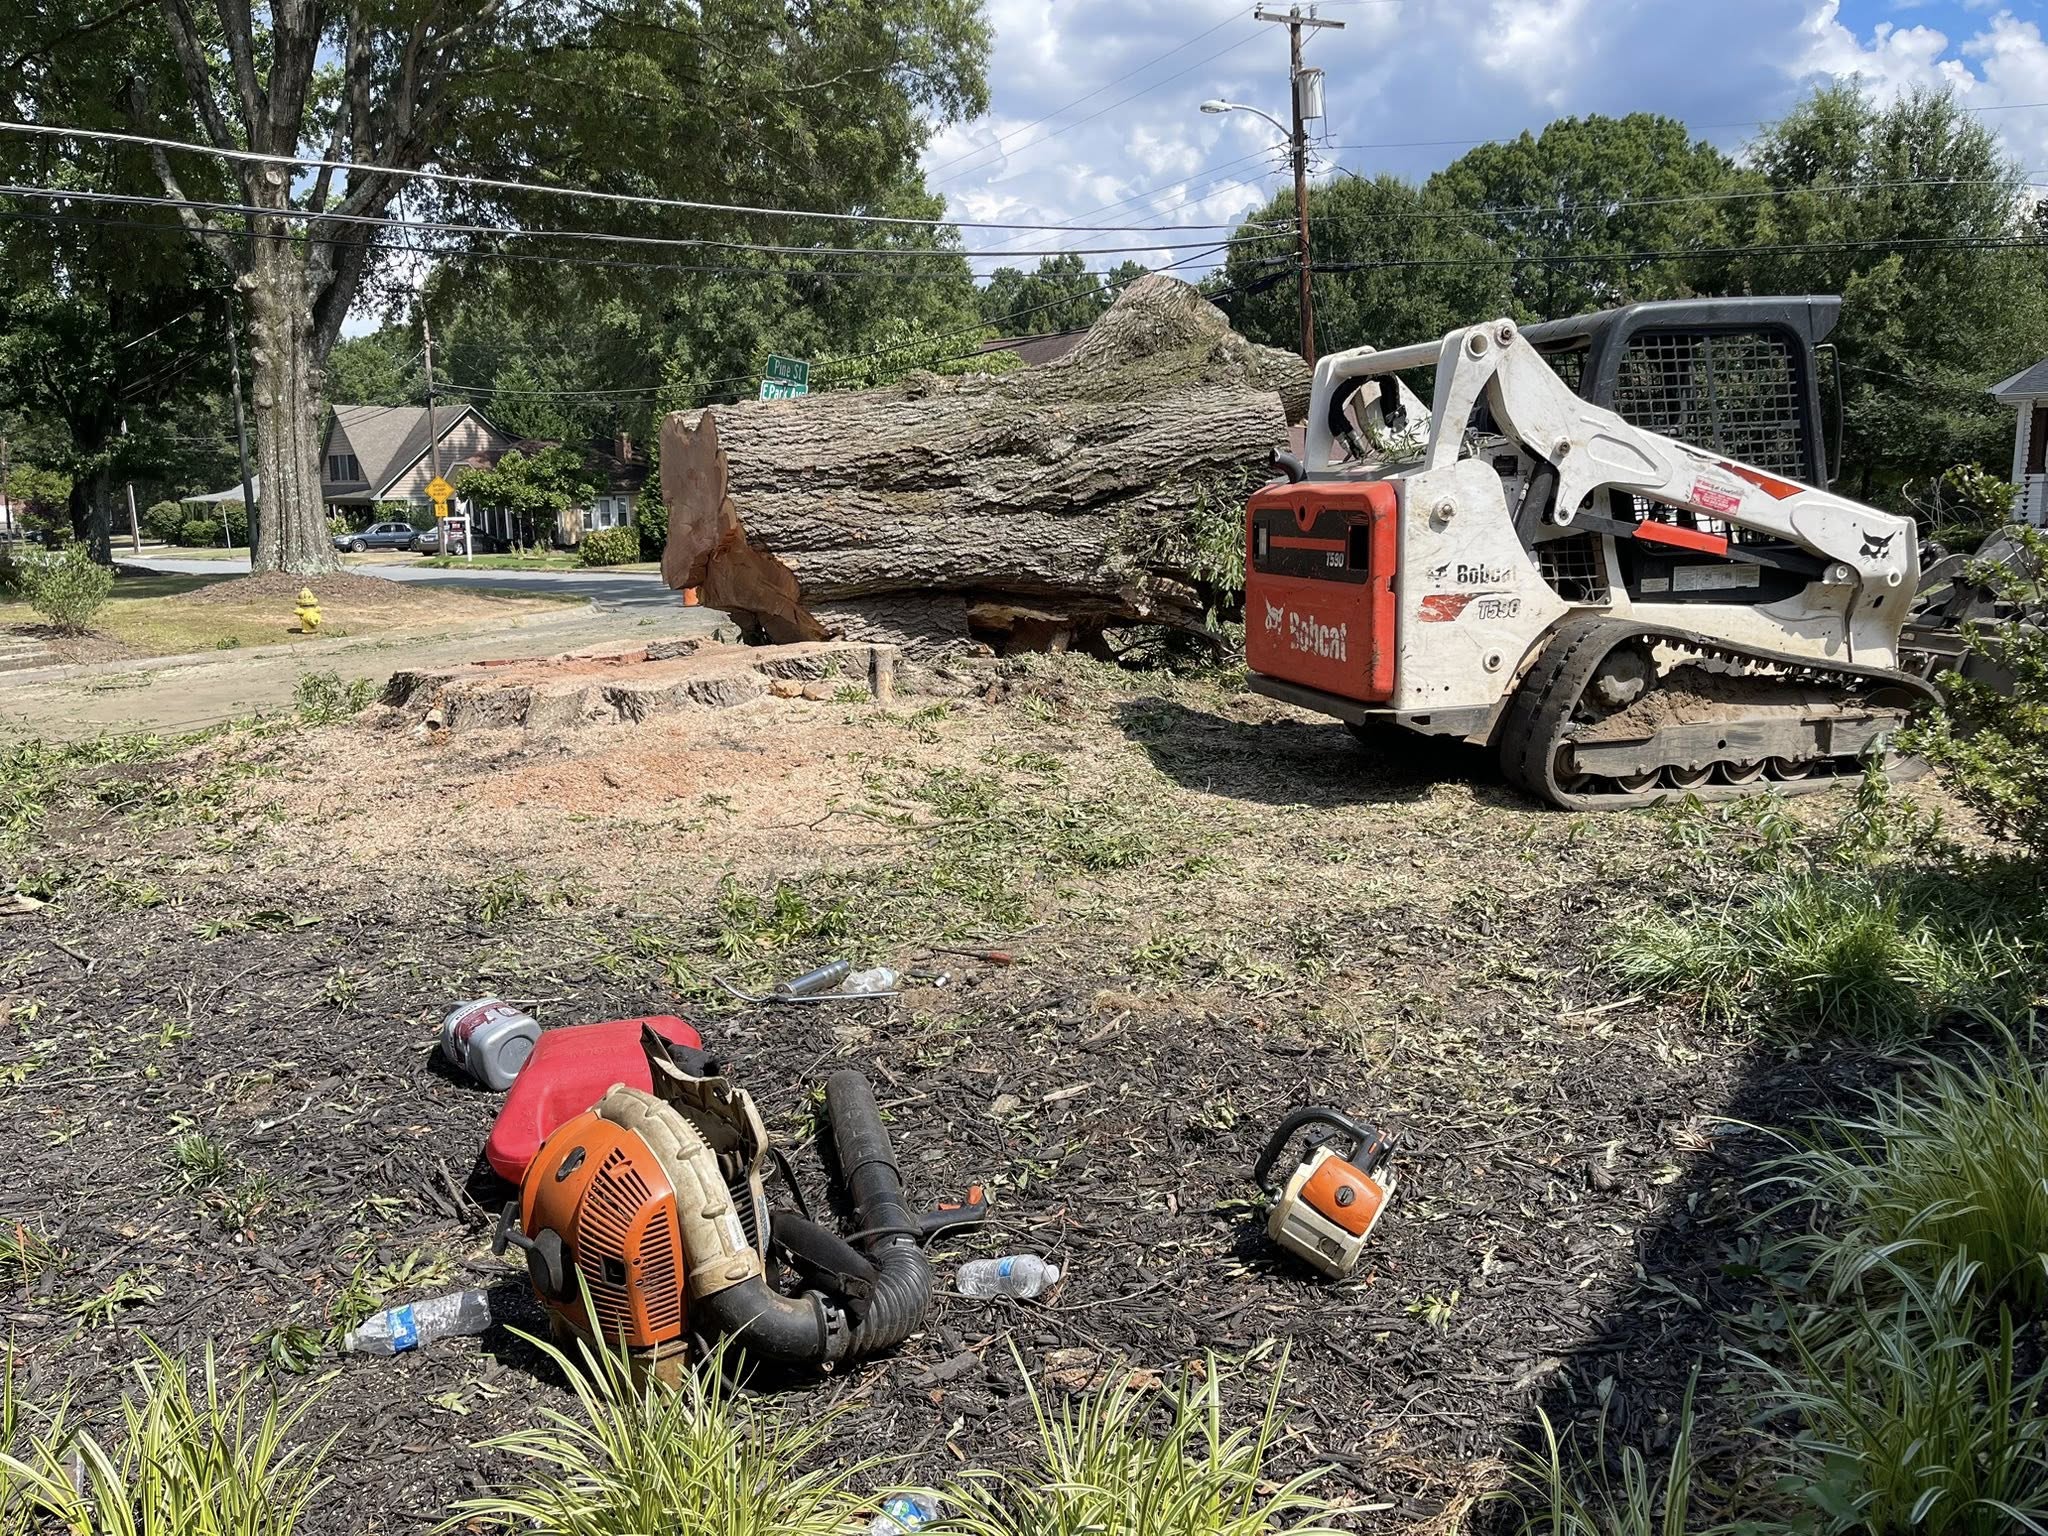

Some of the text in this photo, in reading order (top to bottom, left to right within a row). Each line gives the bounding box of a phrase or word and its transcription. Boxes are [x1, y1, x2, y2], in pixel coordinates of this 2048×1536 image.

[775, 359, 802, 380] Pine St
[769, 384, 788, 400] Park
[1326, 552, 1345, 568] T590
[1478, 598, 1521, 620] T590
